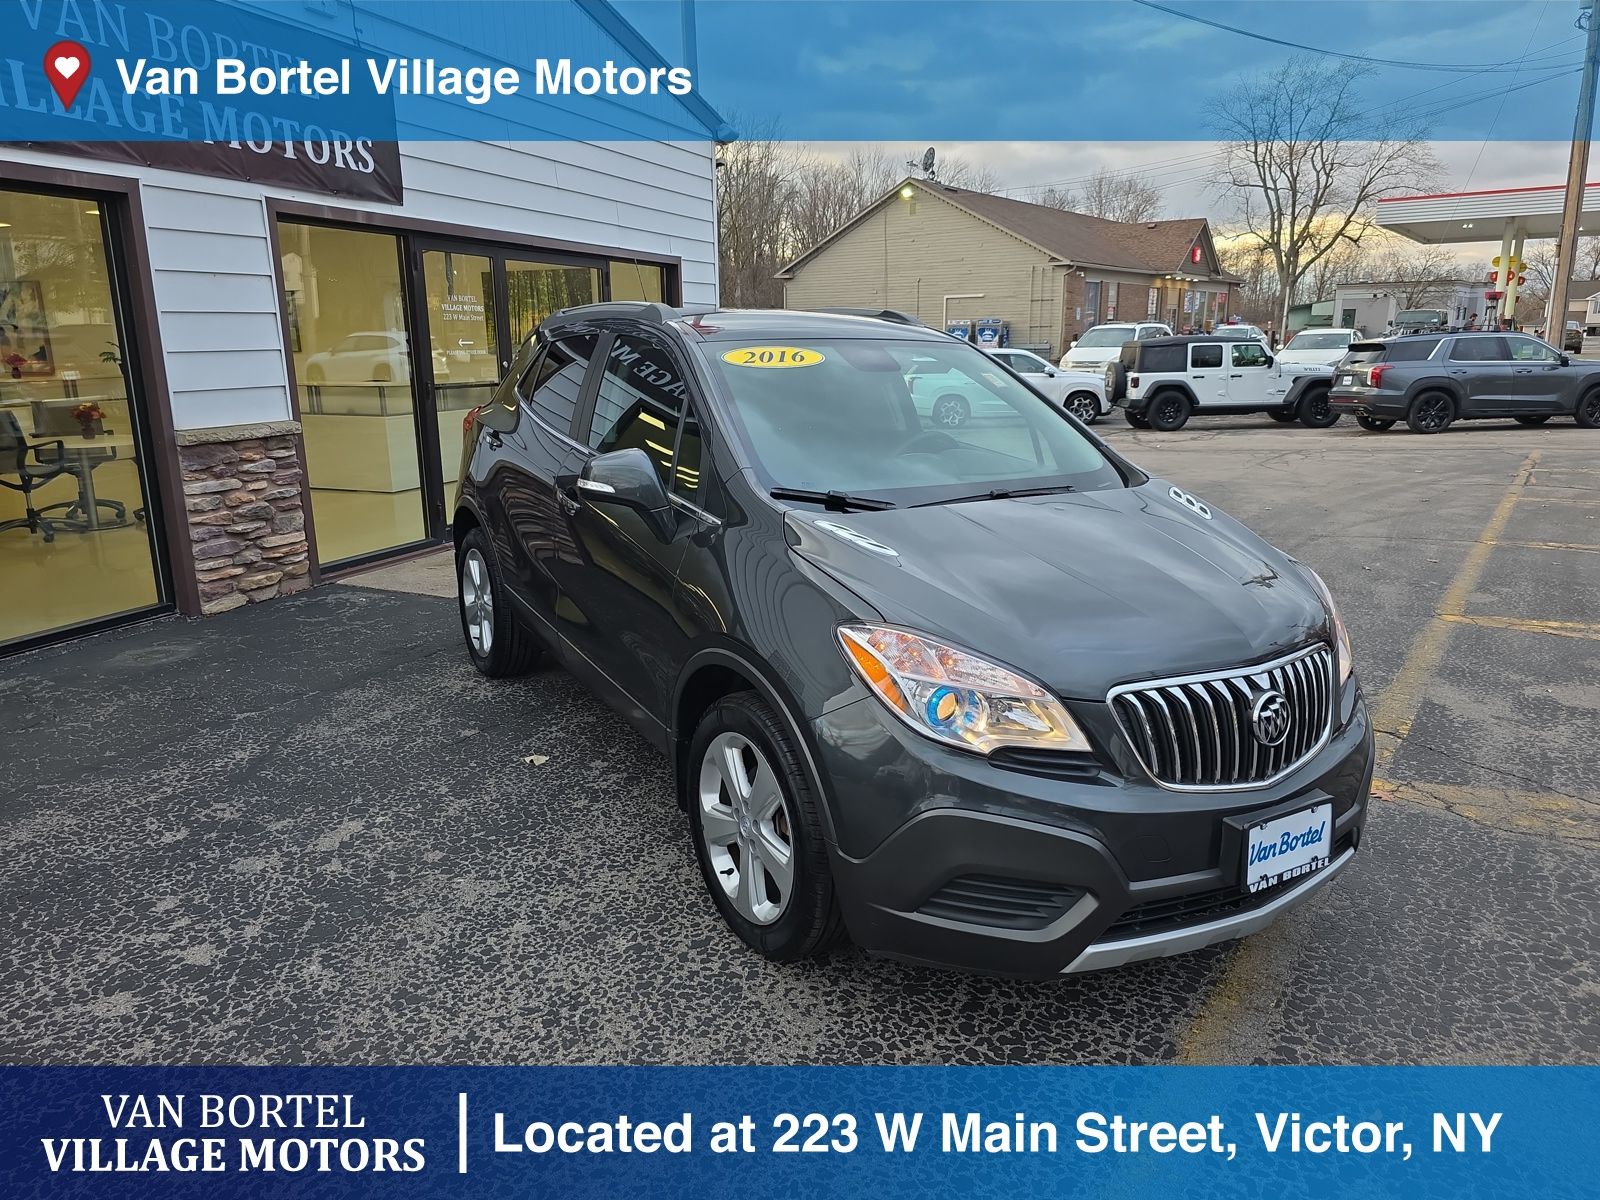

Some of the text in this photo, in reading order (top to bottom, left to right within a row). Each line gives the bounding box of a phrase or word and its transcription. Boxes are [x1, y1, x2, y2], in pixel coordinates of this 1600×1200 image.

[19, 0, 131, 52] VAN
[199, 100, 375, 174] MOTORS
[441, 303, 485, 312] VILLAGE MOTORS
[743, 350, 806, 364] 2016
[1249, 821, 1326, 866] Van Bortel
[1249, 856, 1330, 893] VAN BORTEL
